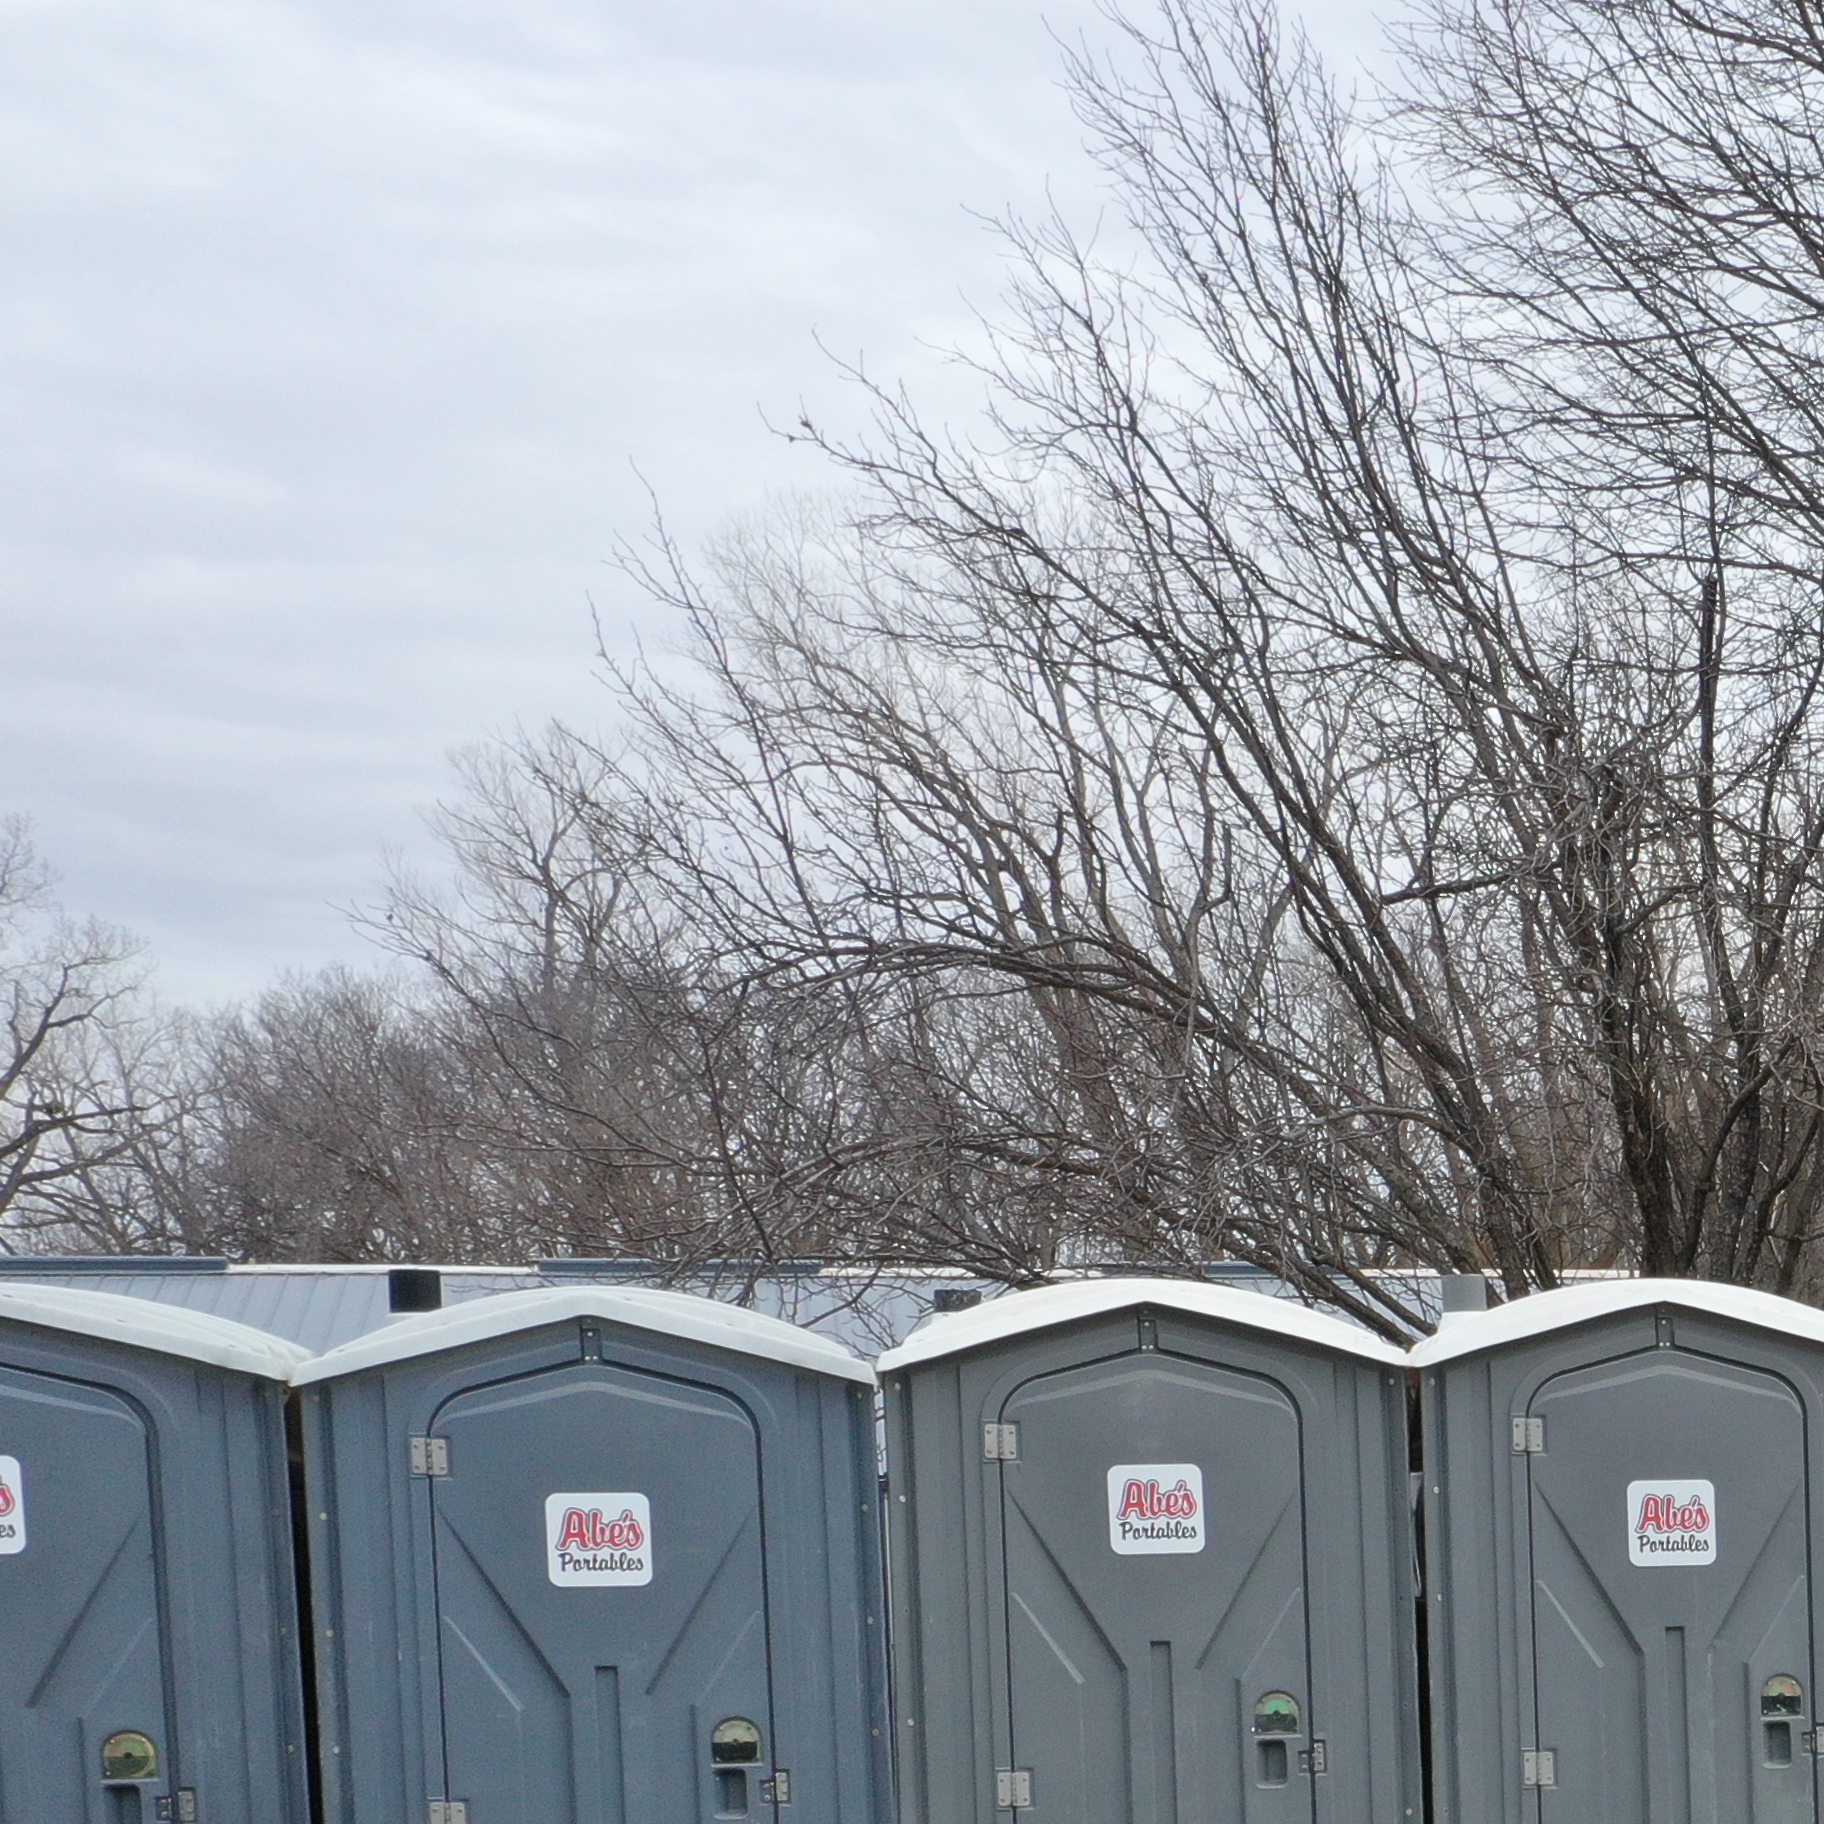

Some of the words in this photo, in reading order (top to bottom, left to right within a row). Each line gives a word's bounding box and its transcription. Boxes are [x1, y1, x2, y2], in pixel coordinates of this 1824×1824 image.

[1116, 1478, 1197, 1520] Abe's
[1635, 1493, 1709, 1534] Abe's
[556, 1507, 644, 1551] Abe's
[1118, 1520, 1197, 1541] Portables
[1637, 1534, 1709, 1553] Portables
[557, 1552, 644, 1572] Portables
